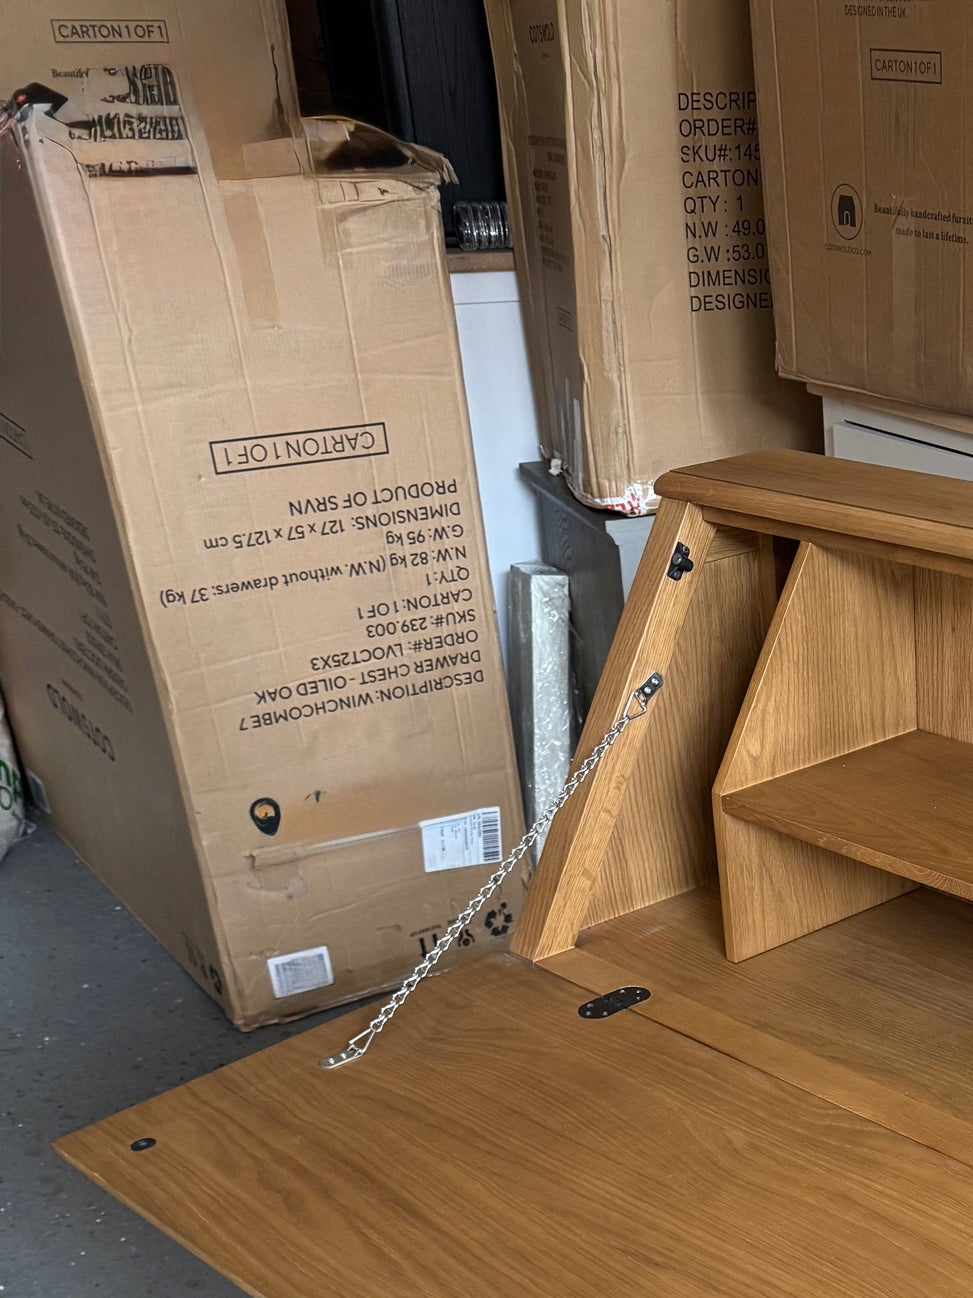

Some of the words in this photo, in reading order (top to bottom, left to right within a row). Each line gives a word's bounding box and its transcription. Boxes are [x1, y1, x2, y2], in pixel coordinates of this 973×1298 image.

[58, 24, 122, 38] CARTON
[125, 24, 130, 38] 1
[134, 24, 155, 38] OF
[157, 24, 164, 38] 1
[875, 58, 912, 74] CARTON
[919, 61, 931, 74] OF
[736, 195, 743, 212] 1
[911, 208, 950, 222] handcrafted
[914, 228, 921, 238] to
[922, 228, 934, 239] last
[690, 292, 773, 312] DESIGNE
[237, 443, 268, 465] OF
[272, 442, 282, 460] 1
[285, 431, 375, 459] CARTON
[224, 447, 233, 466] 1
[342, 491, 368, 509] OF
[371, 478, 458, 505] PRODUCT
[288, 495, 339, 517] SRVN
[350, 502, 461, 530] DIMENSIONS:
[272, 528, 284, 539] x
[287, 524, 306, 542] 57
[306, 522, 317, 534] x
[320, 519, 346, 536] 127
[428, 524, 464, 542] G.W:
[203, 536, 229, 550] cm
[232, 530, 272, 550] 127.5
[385, 530, 404, 546] kg
[406, 529, 426, 545] 95
[389, 552, 408, 568] kg
[410, 551, 429, 567] 82
[431, 545, 467, 563] N.W:
[344, 554, 386, 578] (N.W.
[433, 565, 470, 584] QTY:
[281, 565, 344, 587] without
[425, 572, 432, 587] 1
[211, 576, 279, 596] drawers:
[159, 588, 187, 609] kg)
[190, 587, 210, 604] 37
[401, 588, 473, 612] CARTON:
[357, 607, 364, 620] 1
[367, 602, 390, 619] OF
[393, 600, 400, 614] 1
[366, 616, 428, 638] 239.003
[430, 608, 476, 628] SKU#:
[407, 629, 479, 653] ORDER#:
[310, 642, 404, 671] LVOCT25X3
[413, 649, 482, 674] DRAWER
[359, 663, 411, 686] CHEST
[296, 675, 348, 696] OILED
[375, 669, 484, 702] DESCRIPTION:
[253, 686, 293, 705] OAK
[249, 692, 374, 729] WINCHCOMBE
[238, 717, 249, 732] 7
